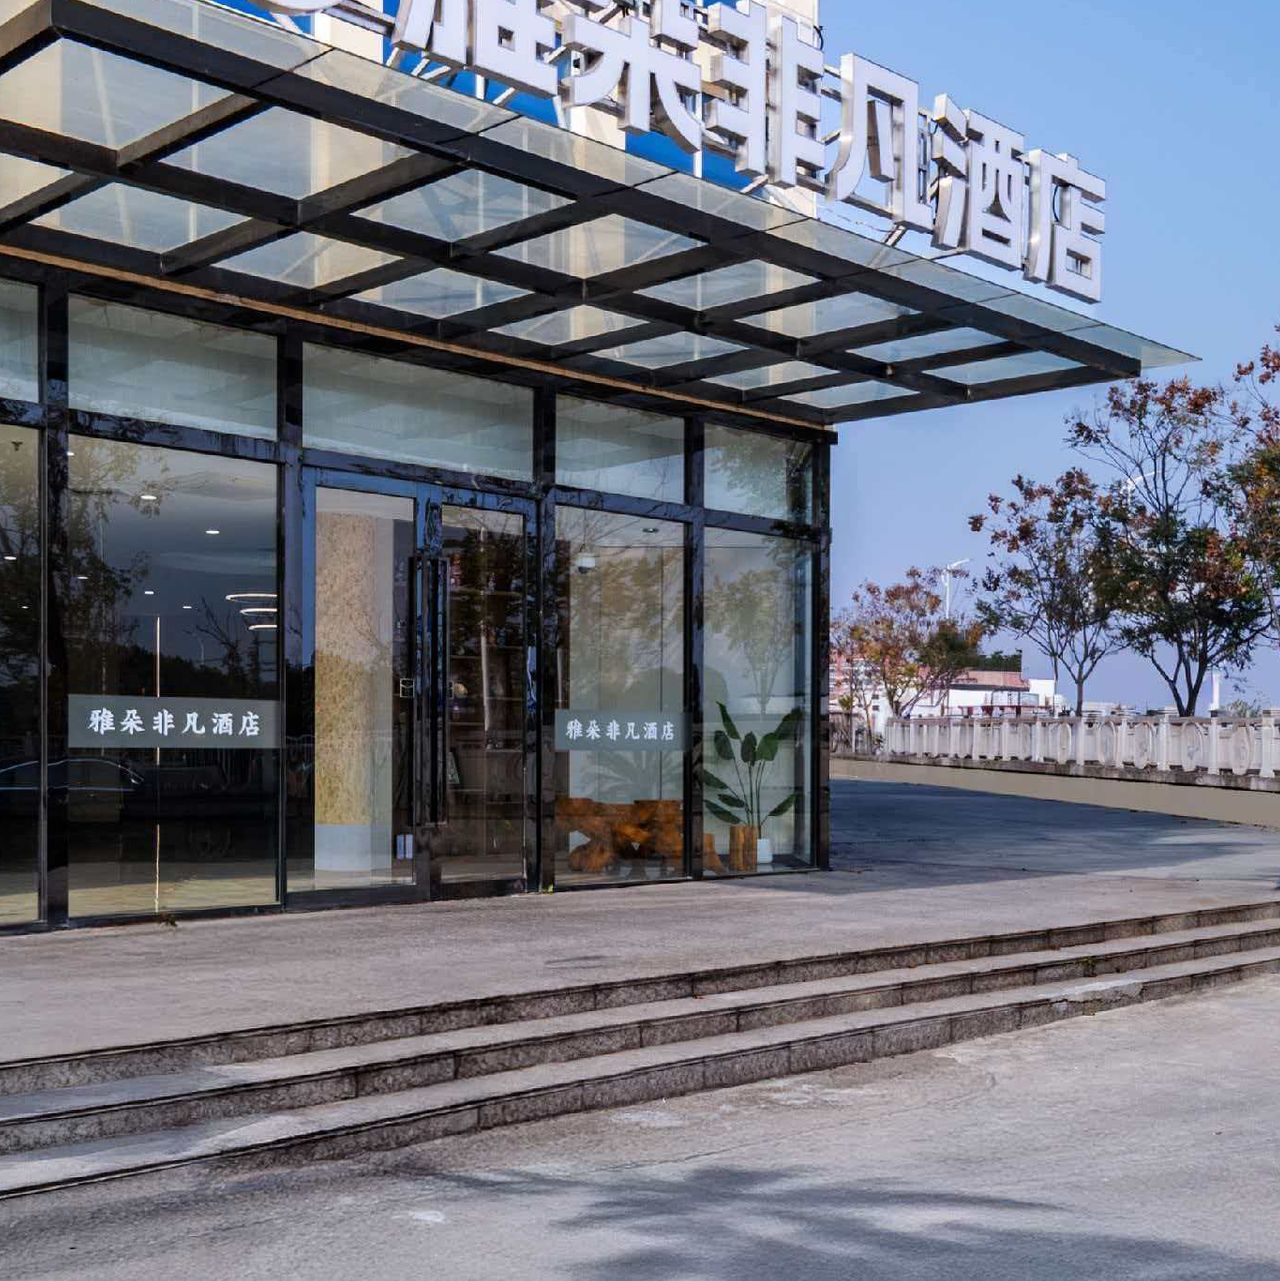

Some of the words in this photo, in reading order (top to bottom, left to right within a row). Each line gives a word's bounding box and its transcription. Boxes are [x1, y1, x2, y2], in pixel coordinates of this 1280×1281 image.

[88, 707, 260, 735] 雅朵非凡酒店
[566, 719, 675, 741] 雅朵非凡酒店
